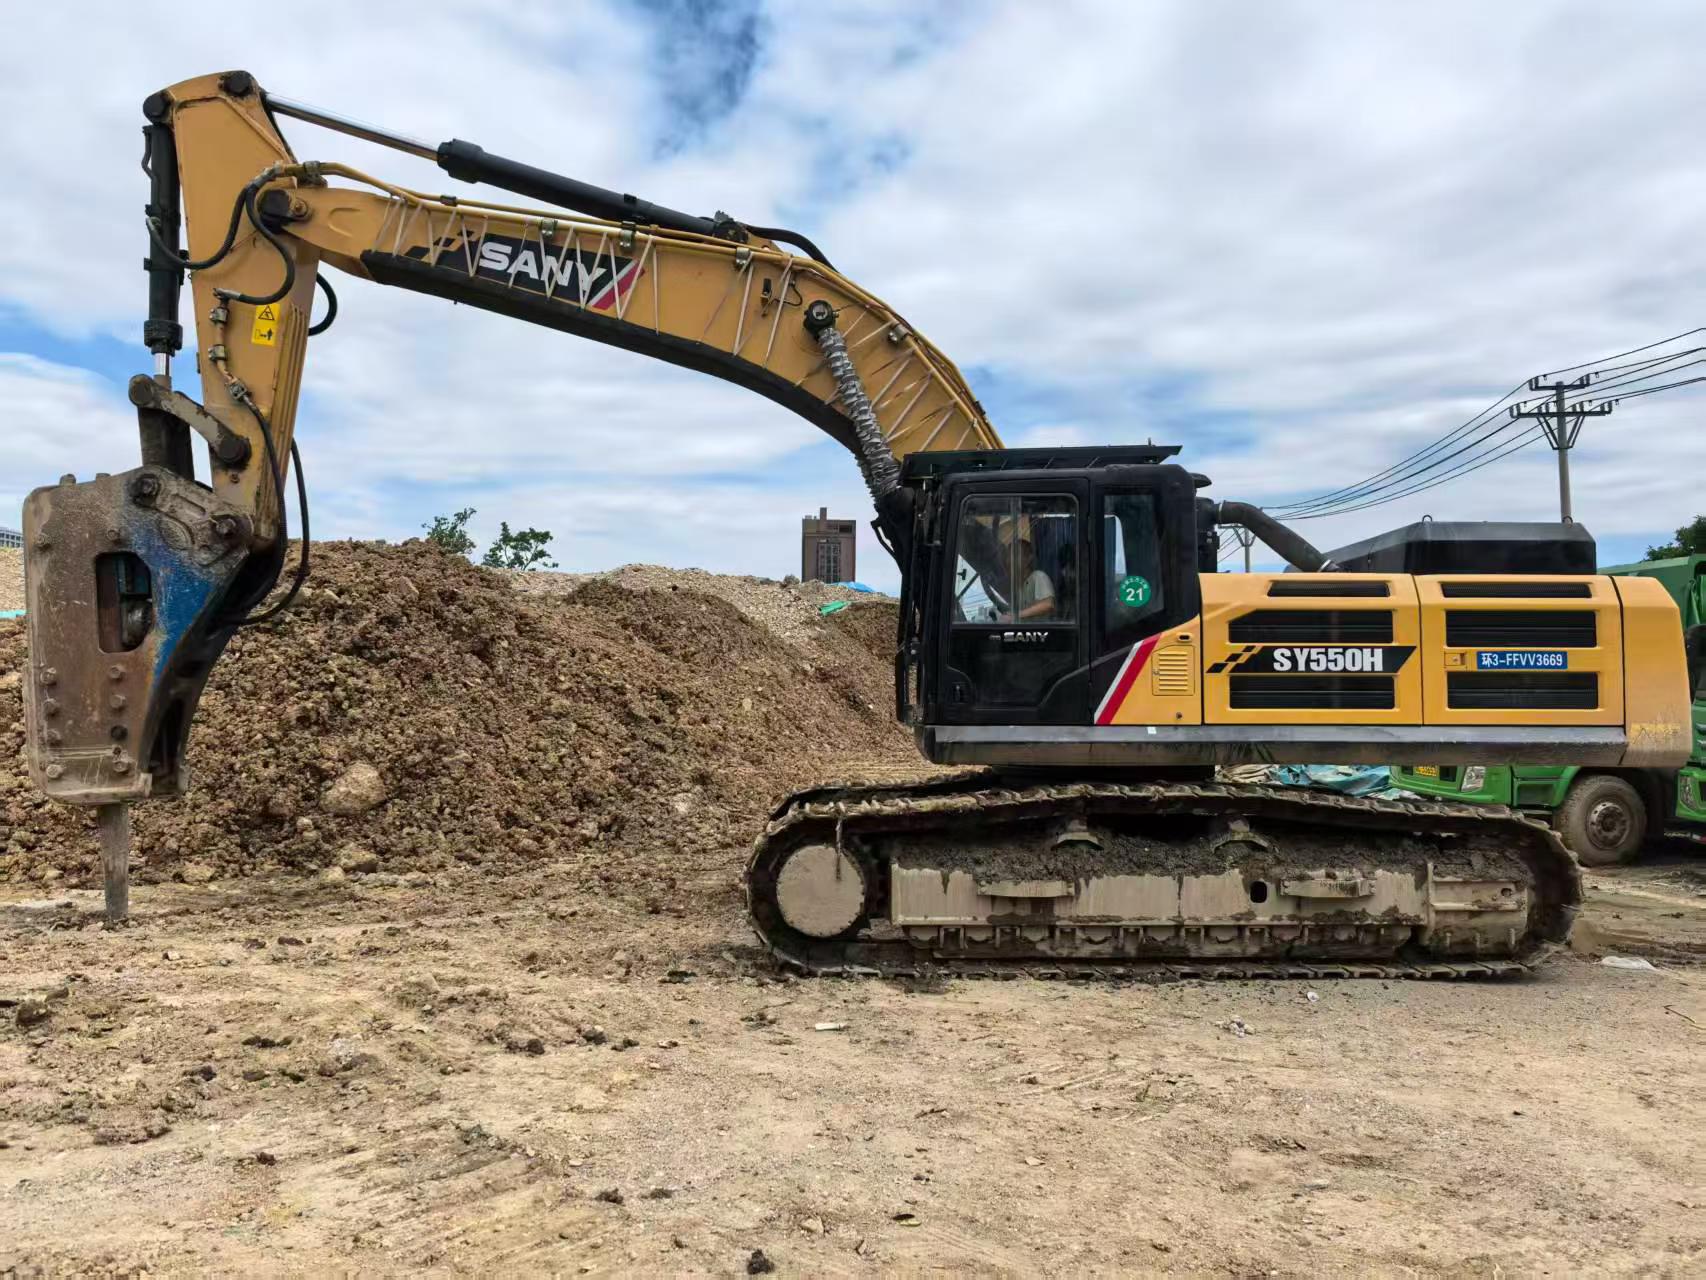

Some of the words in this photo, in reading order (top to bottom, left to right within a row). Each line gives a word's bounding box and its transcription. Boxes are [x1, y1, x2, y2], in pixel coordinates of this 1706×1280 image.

[478, 241, 608, 293] SANY
[1126, 588, 1143, 601] 21
[1003, 631, 1049, 642] SANY
[1273, 647, 1384, 672] SY550H
